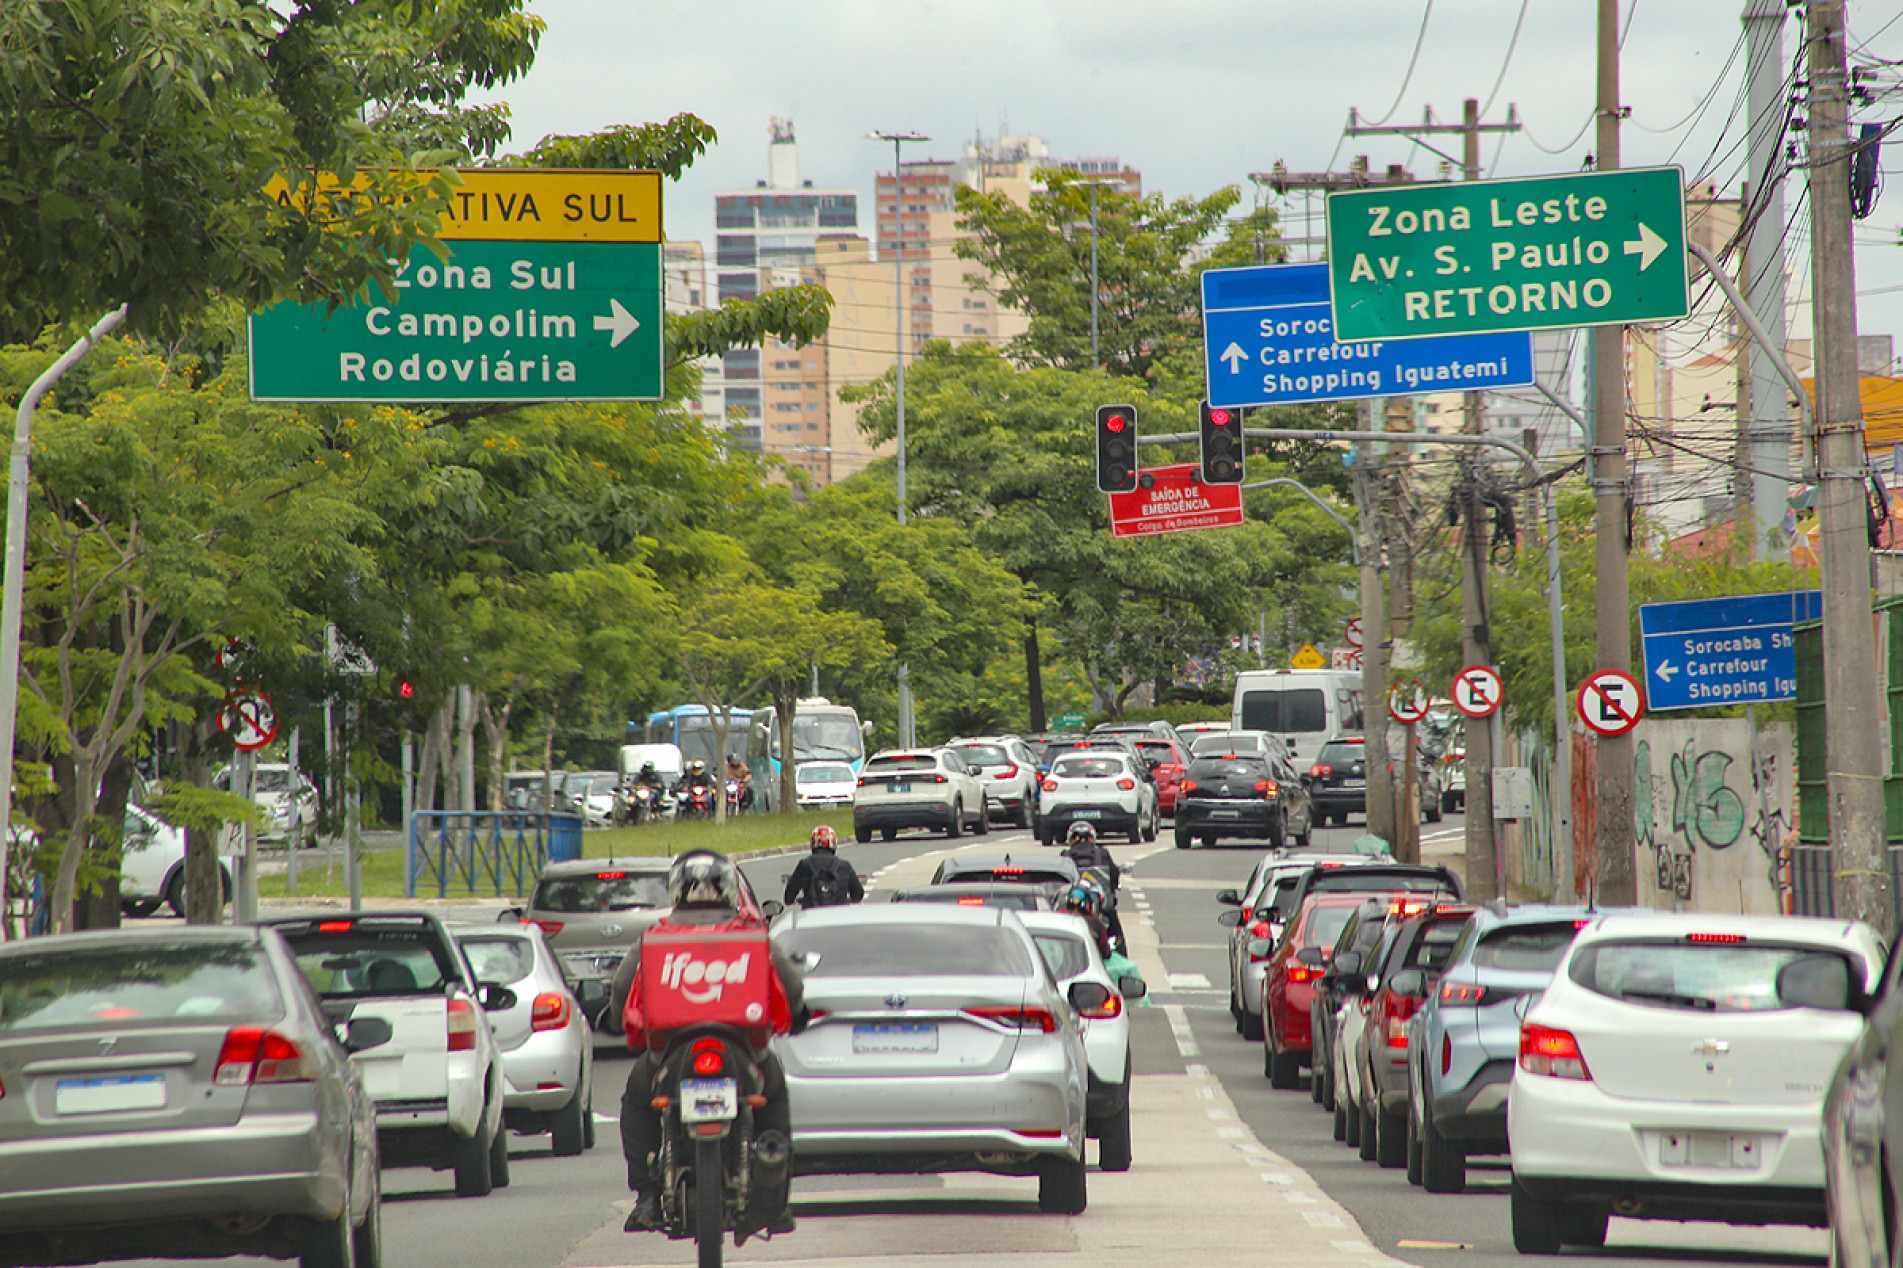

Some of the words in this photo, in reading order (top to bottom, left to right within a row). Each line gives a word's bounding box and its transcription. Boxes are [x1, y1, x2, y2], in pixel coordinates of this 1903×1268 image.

[563, 193, 638, 223] SUL
[1367, 205, 1471, 237] Zona
[1490, 193, 1608, 229] Leste
[1349, 253, 1414, 283] Av.
[1435, 246, 1471, 276] S.
[1491, 237, 1610, 271] Paulo
[510, 261, 577, 291] Sul
[1404, 279, 1612, 321] RETORNO
[366, 307, 577, 344] Campolim
[1260, 318, 1331, 337] Soroc
[340, 350, 577, 383] Rodoviária
[1260, 343, 1383, 366] Carrefour
[1263, 369, 1381, 394] Shopping
[1395, 357, 1508, 387] Iguatemi
[1142, 498, 1210, 516] EMERGÊNCIA
[1151, 486, 1182, 502] SAÍDA
[1184, 486, 1199, 498] DE
[1684, 636, 1762, 655] Sorocaba
[1771, 632, 1793, 648] Sh
[1686, 658, 1768, 677] Carrefour
[1688, 680, 1768, 699] Shopping
